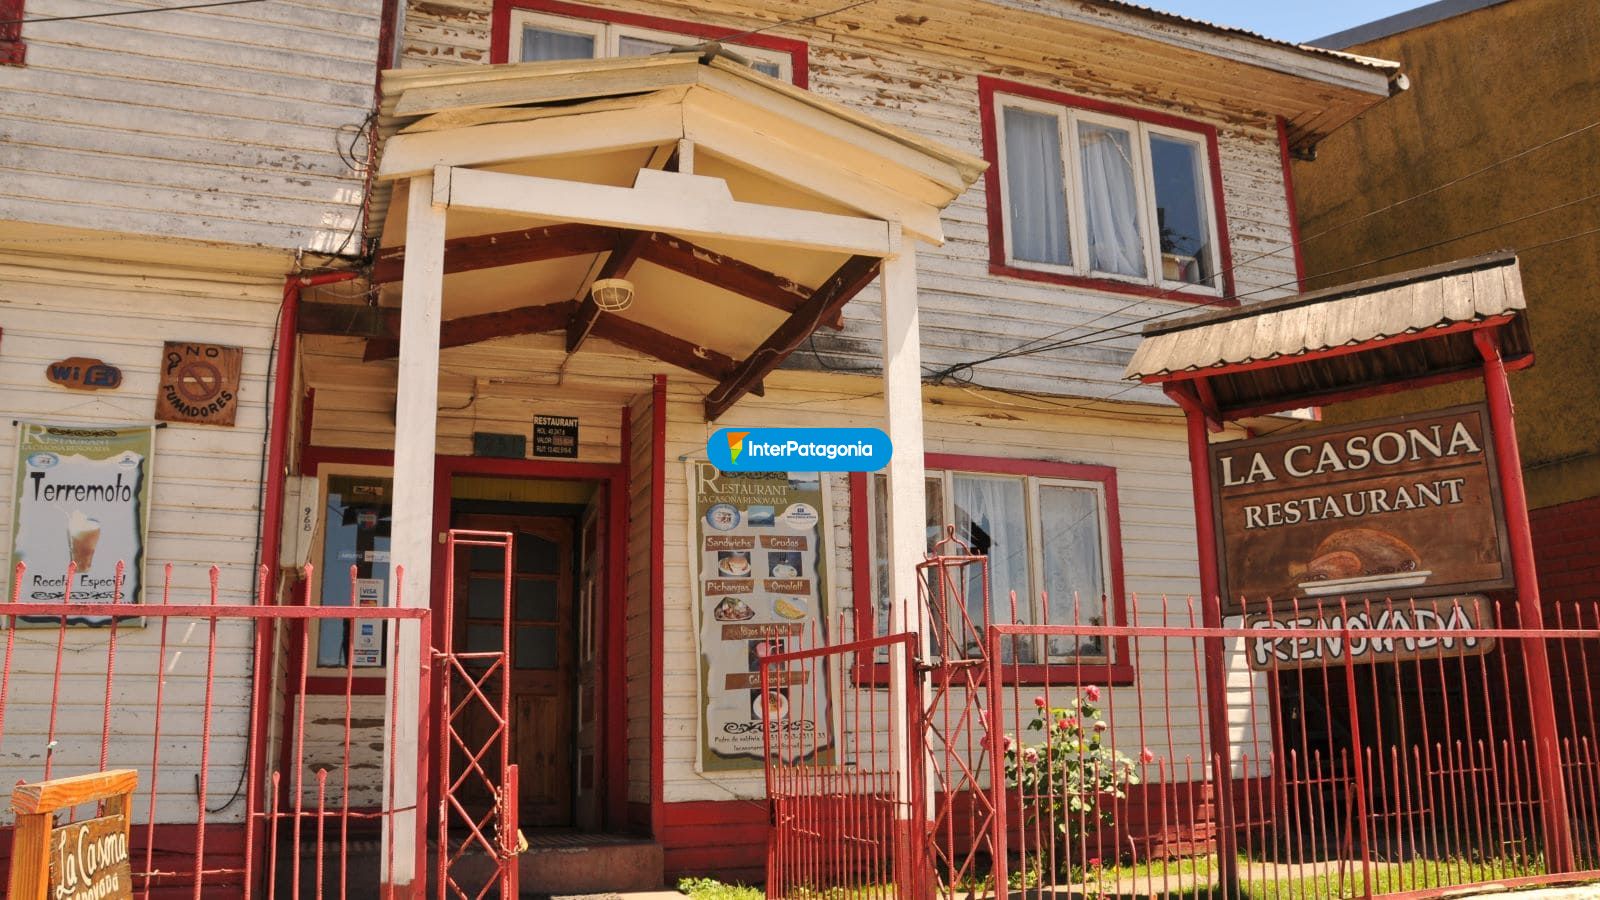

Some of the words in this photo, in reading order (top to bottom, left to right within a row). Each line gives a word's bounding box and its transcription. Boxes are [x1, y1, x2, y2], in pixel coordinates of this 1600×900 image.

[186, 346, 219, 358] NO
[163, 384, 233, 418] FUMADORES
[534, 416, 578, 427] RESTAURANT
[1219, 452, 1276, 488] LA
[1283, 421, 1481, 478] CASONA
[30, 472, 131, 503] Terremoto
[696, 463, 788, 496] RESTAURANT
[1244, 478, 1465, 529] RESTAURANT
[707, 537, 752, 547] Sandwichs
[33, 575, 75, 588] Recet
[707, 582, 750, 592] Pichangas
[1250, 605, 1478, 665] RENOVADA
[56, 830, 77, 900] La
[78, 825, 127, 886] Casona
